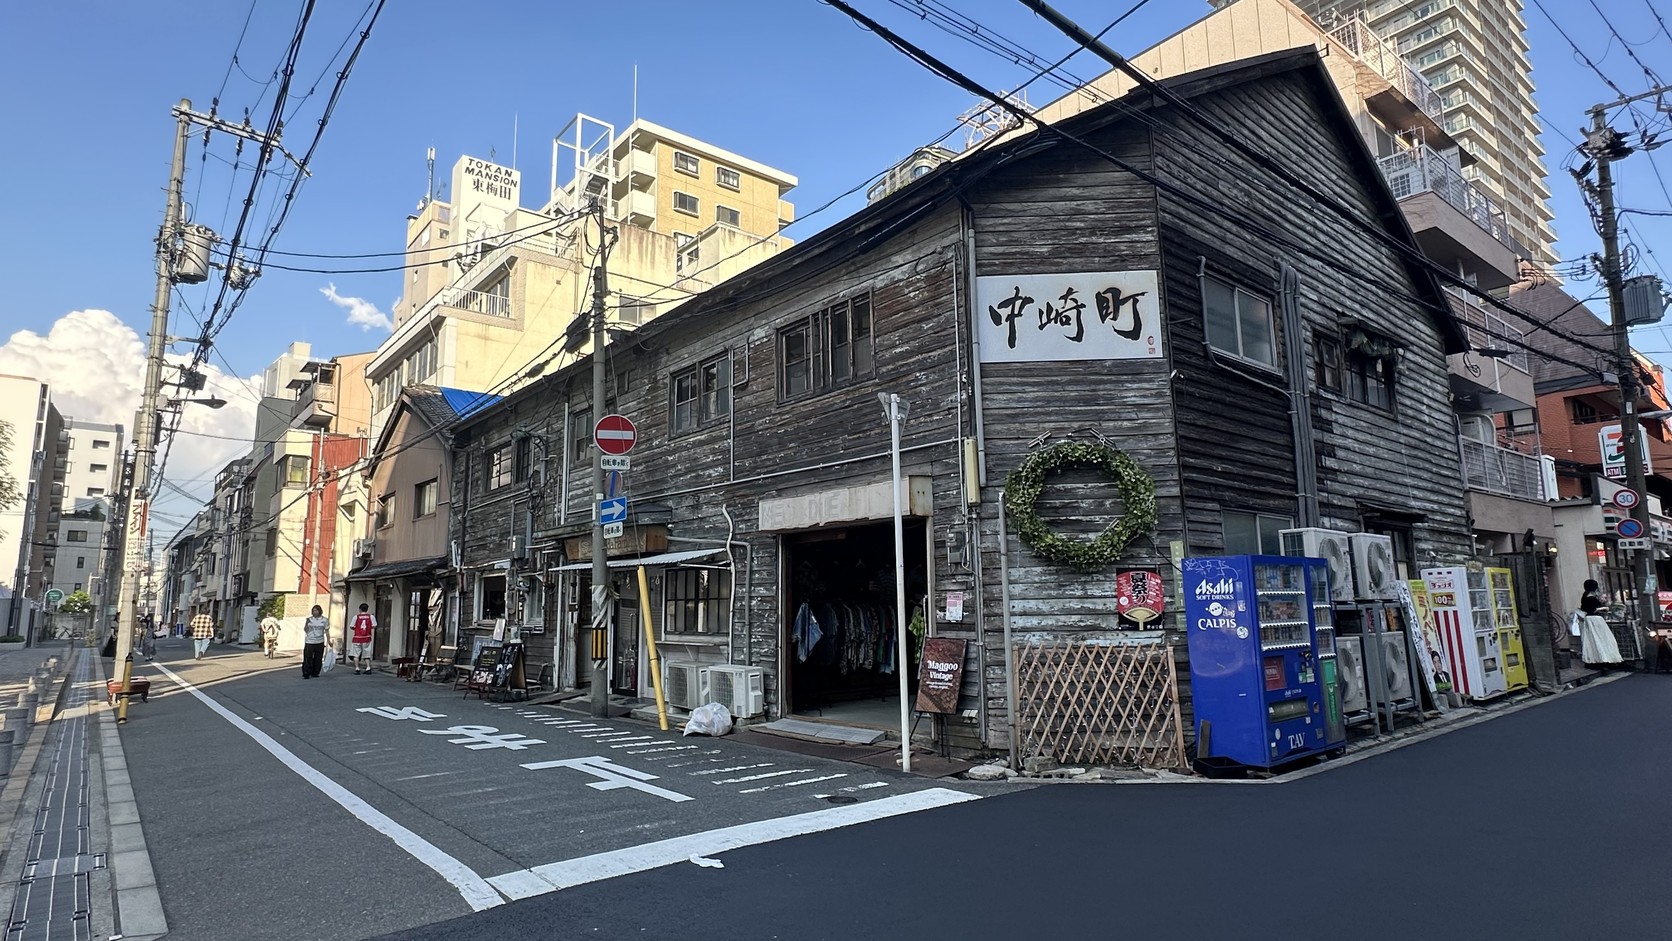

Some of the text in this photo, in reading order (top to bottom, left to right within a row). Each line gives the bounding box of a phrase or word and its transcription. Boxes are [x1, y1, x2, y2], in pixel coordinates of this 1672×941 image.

[468, 158, 513, 178] TOKAN
[465, 166, 518, 188] MANSION
[472, 178, 511, 201] 東梅田
[988, 285, 1148, 349] 中崎町
[1607, 468, 1620, 476] ATM
[1619, 494, 1633, 503] 30
[1195, 578, 1234, 595] Asahi
[1434, 596, 1447, 604] 100
[361, 619, 367, 631] 4
[1198, 618, 1237, 631] CALPIS
[927, 660, 959, 671] Maggoo
[929, 671, 954, 681] Vintage
